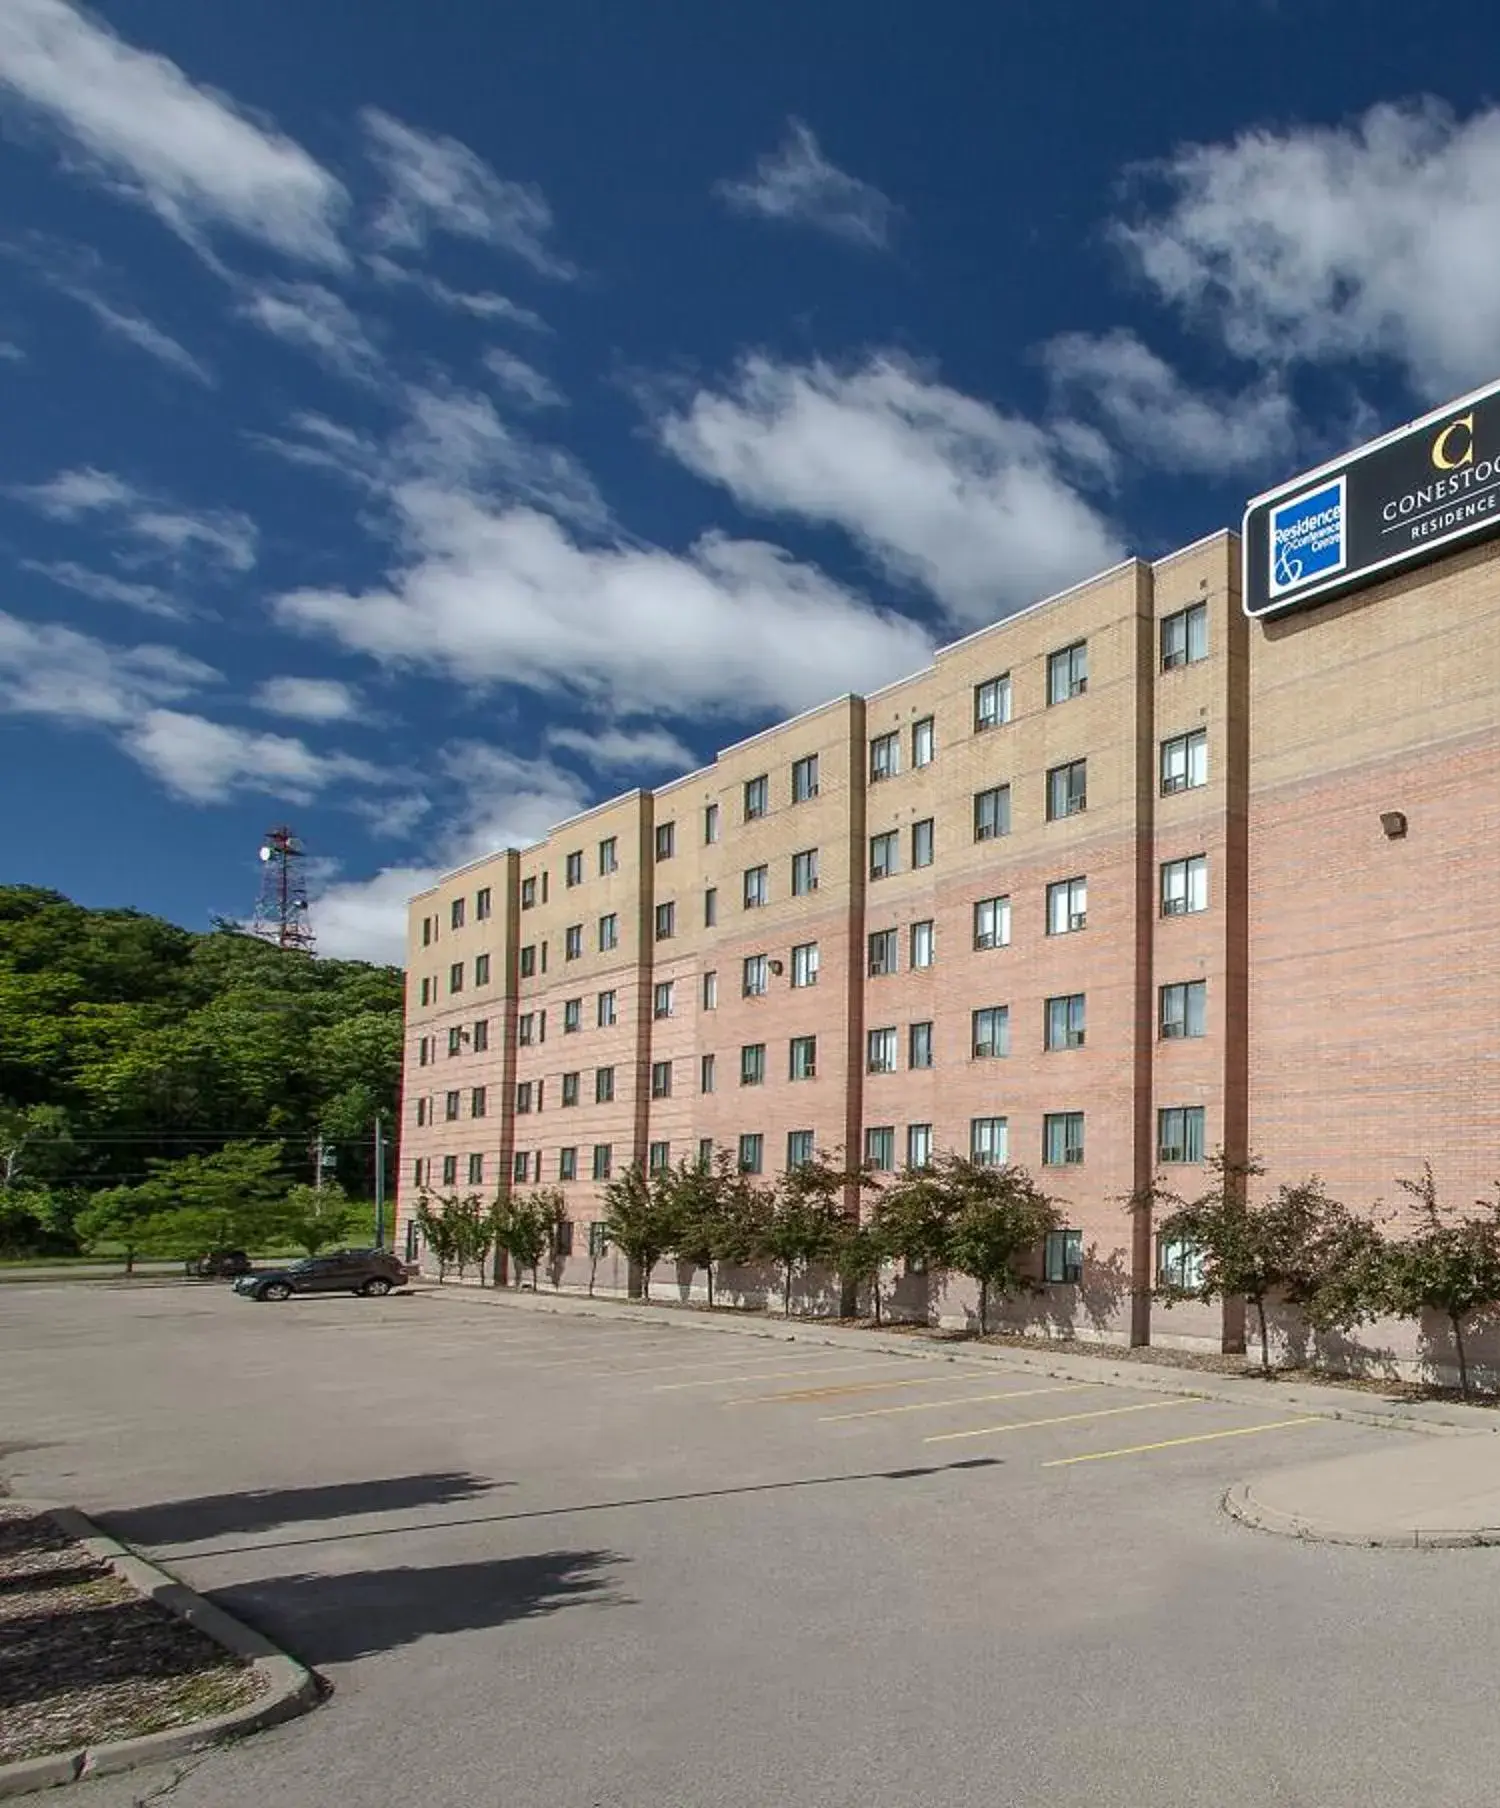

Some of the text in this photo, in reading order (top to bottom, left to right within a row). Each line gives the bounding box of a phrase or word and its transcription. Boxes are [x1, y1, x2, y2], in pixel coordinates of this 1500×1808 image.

[1432, 412, 1473, 469] C
[1275, 505, 1340, 544] Residence
[1411, 494, 1496, 540] RESIDENCE
